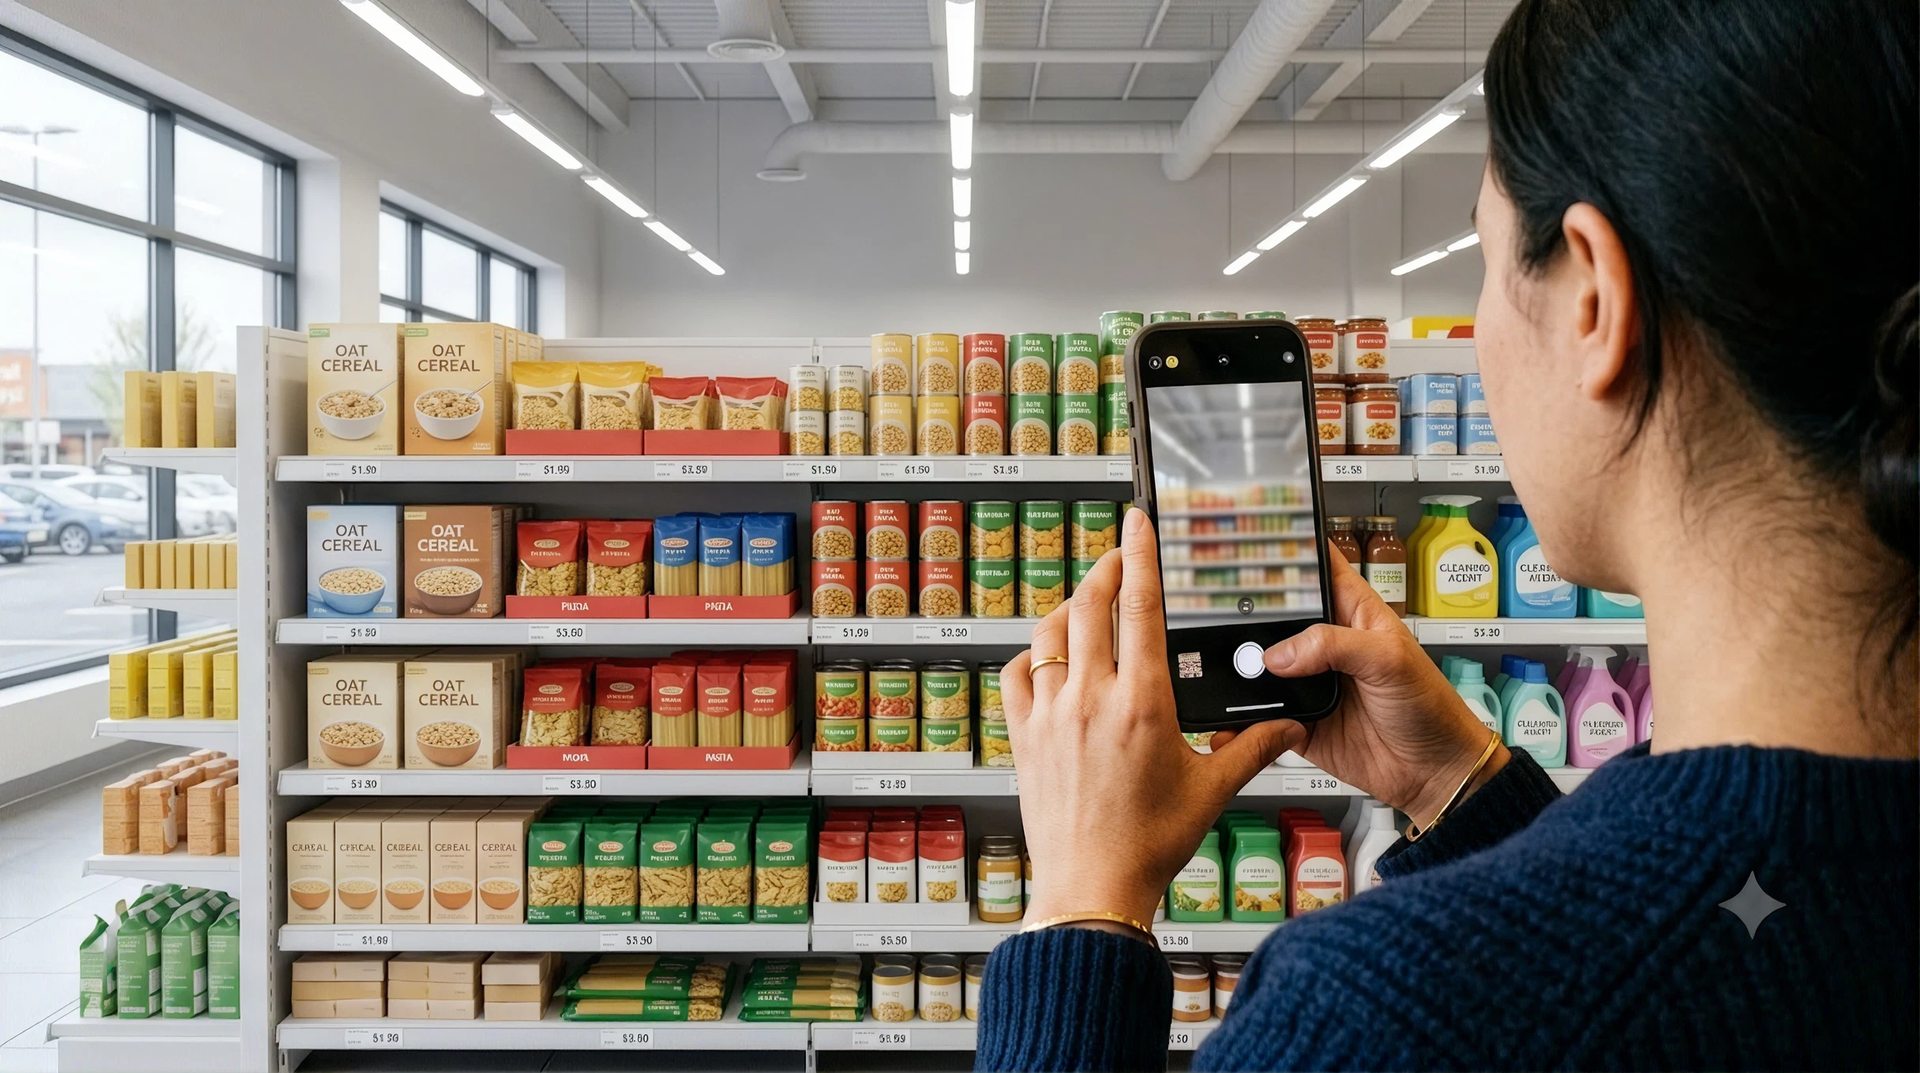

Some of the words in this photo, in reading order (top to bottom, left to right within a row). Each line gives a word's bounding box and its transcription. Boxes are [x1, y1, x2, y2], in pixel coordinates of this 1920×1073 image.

[335, 344, 369, 357] OAT
[432, 344, 466, 357] OAT
[321, 358, 383, 372] CEREAL
[417, 358, 480, 372] CEREAL
[335, 524, 368, 537] OAT
[431, 524, 465, 538] OAT
[321, 538, 383, 552] CEREAL
[417, 538, 479, 552] CEREAL
[335, 679, 368, 691] OAT
[432, 679, 465, 691] OAT
[321, 693, 382, 706] CEREAL
[418, 693, 480, 706] CEREAL
